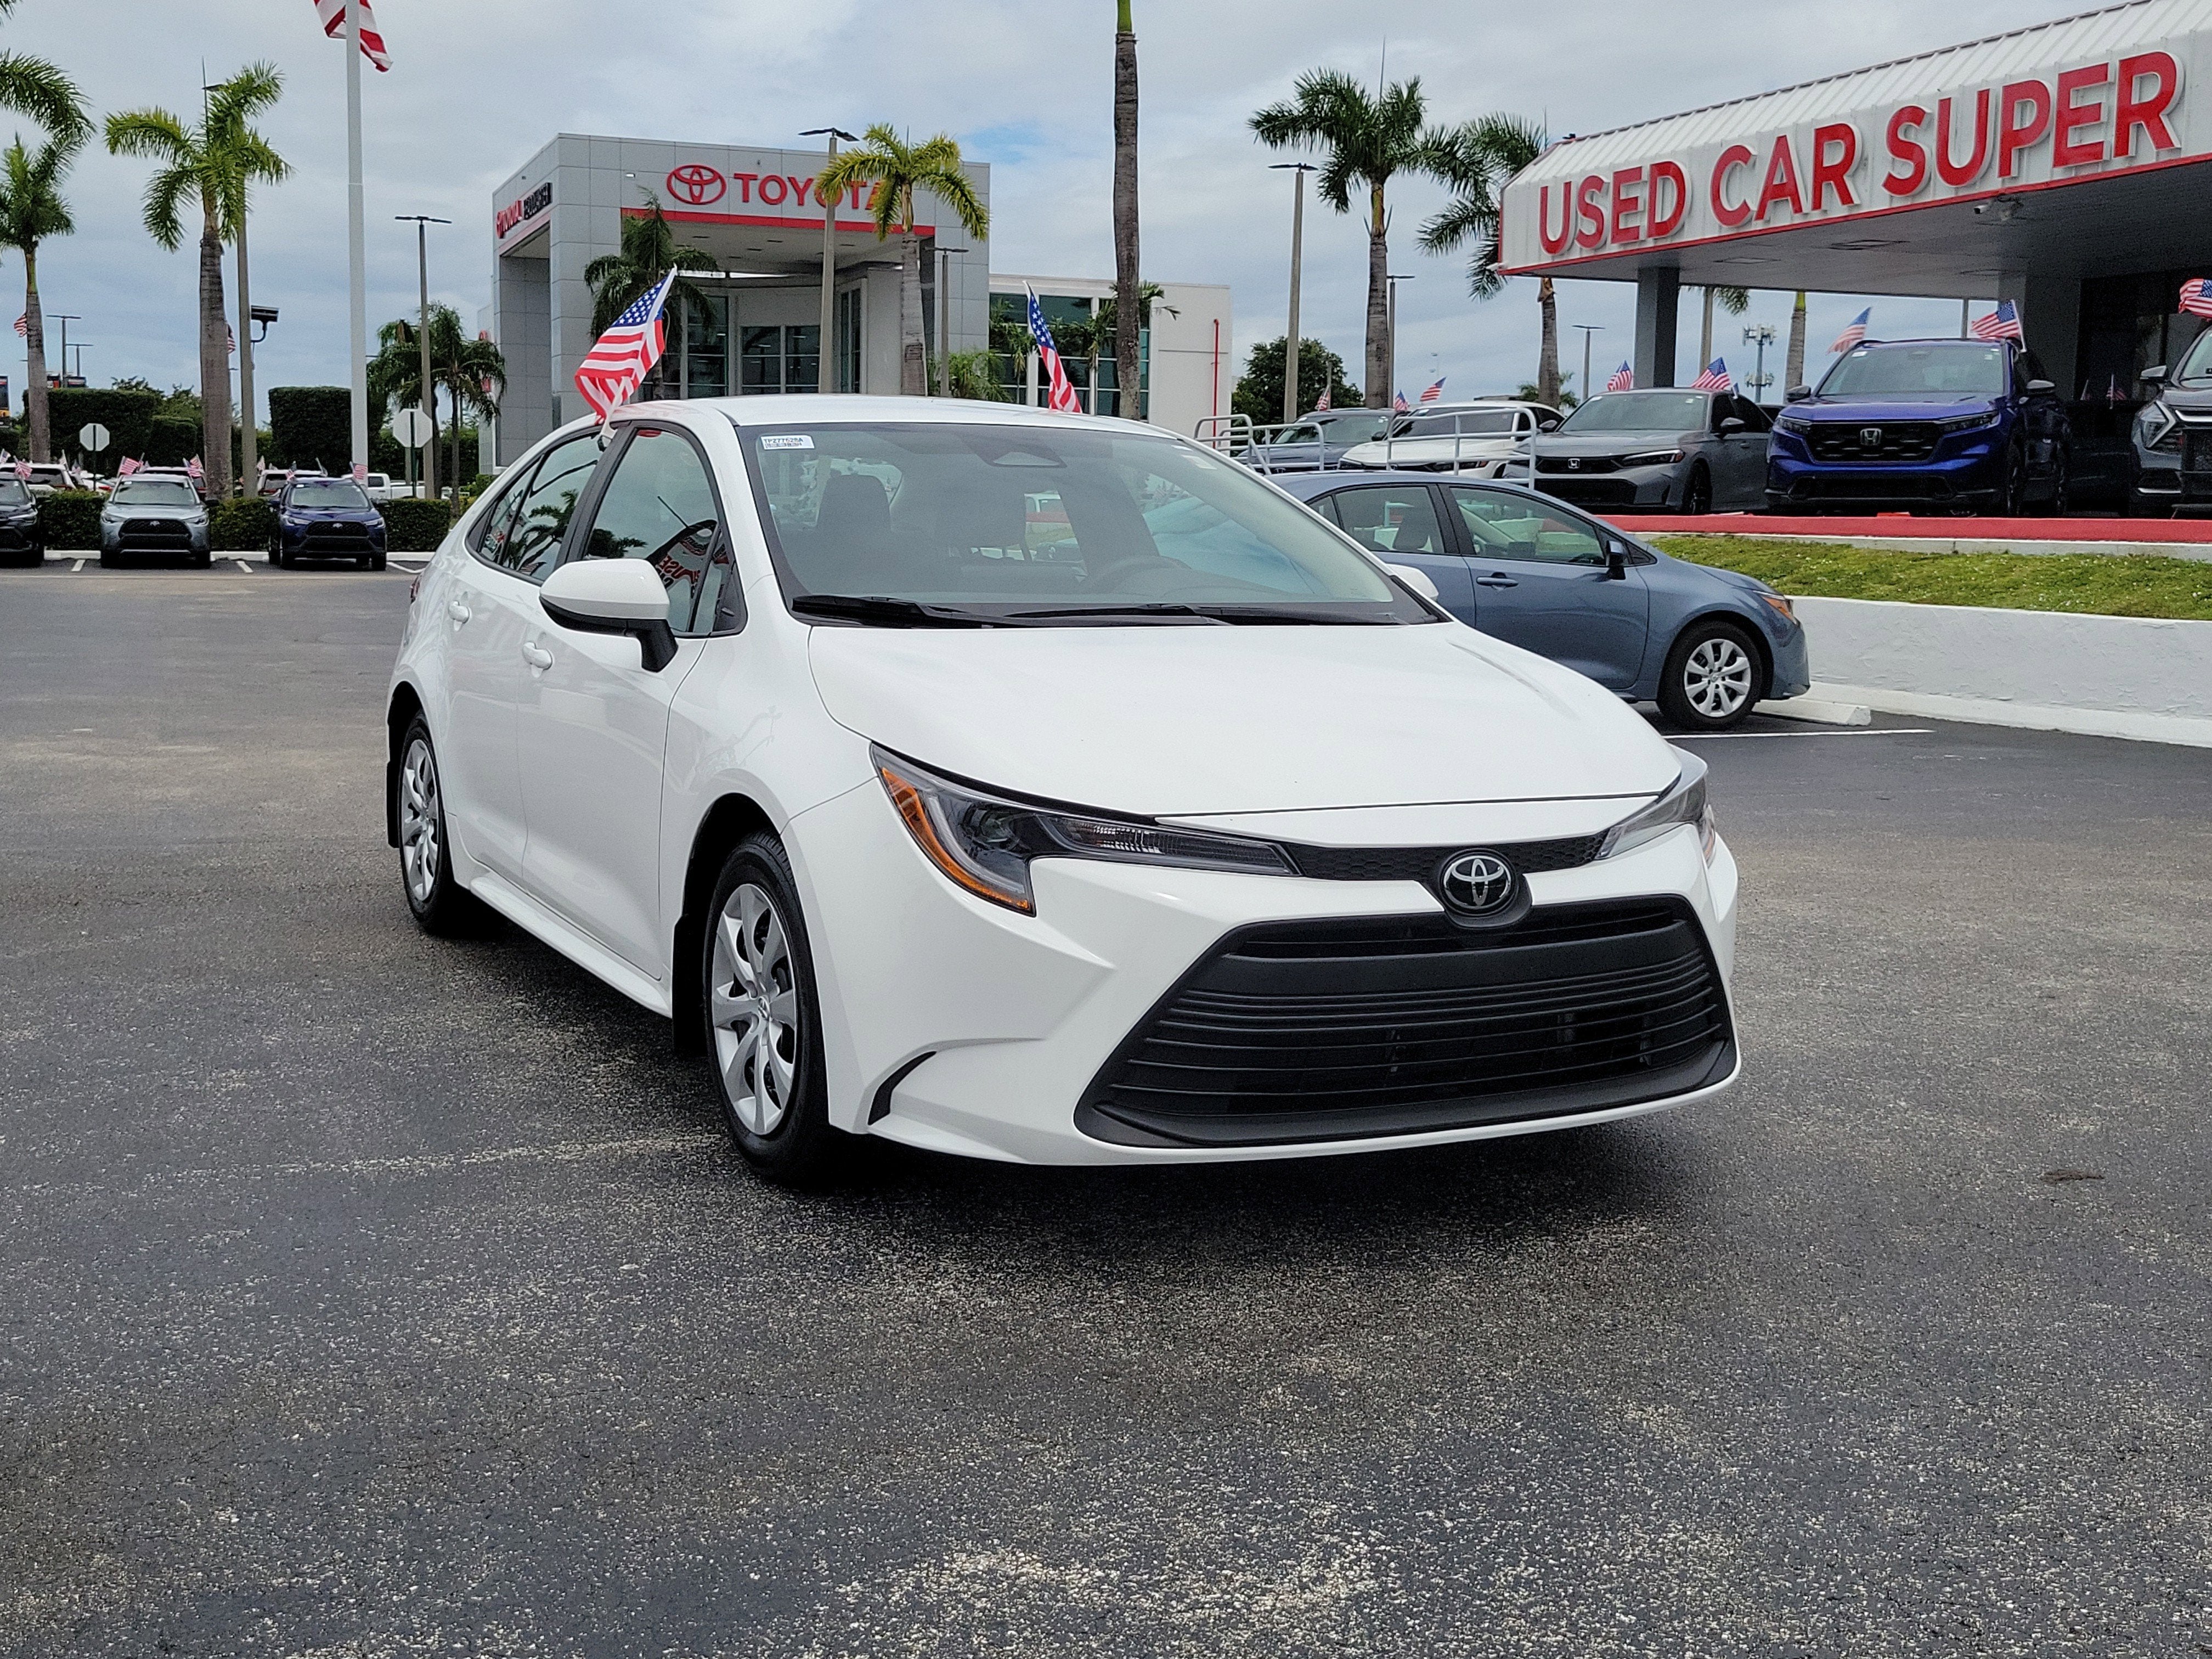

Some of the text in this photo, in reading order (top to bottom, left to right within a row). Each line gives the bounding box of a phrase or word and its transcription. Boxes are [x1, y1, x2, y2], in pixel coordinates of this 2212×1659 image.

[1539, 51, 2179, 255] USED CAR SUPER
